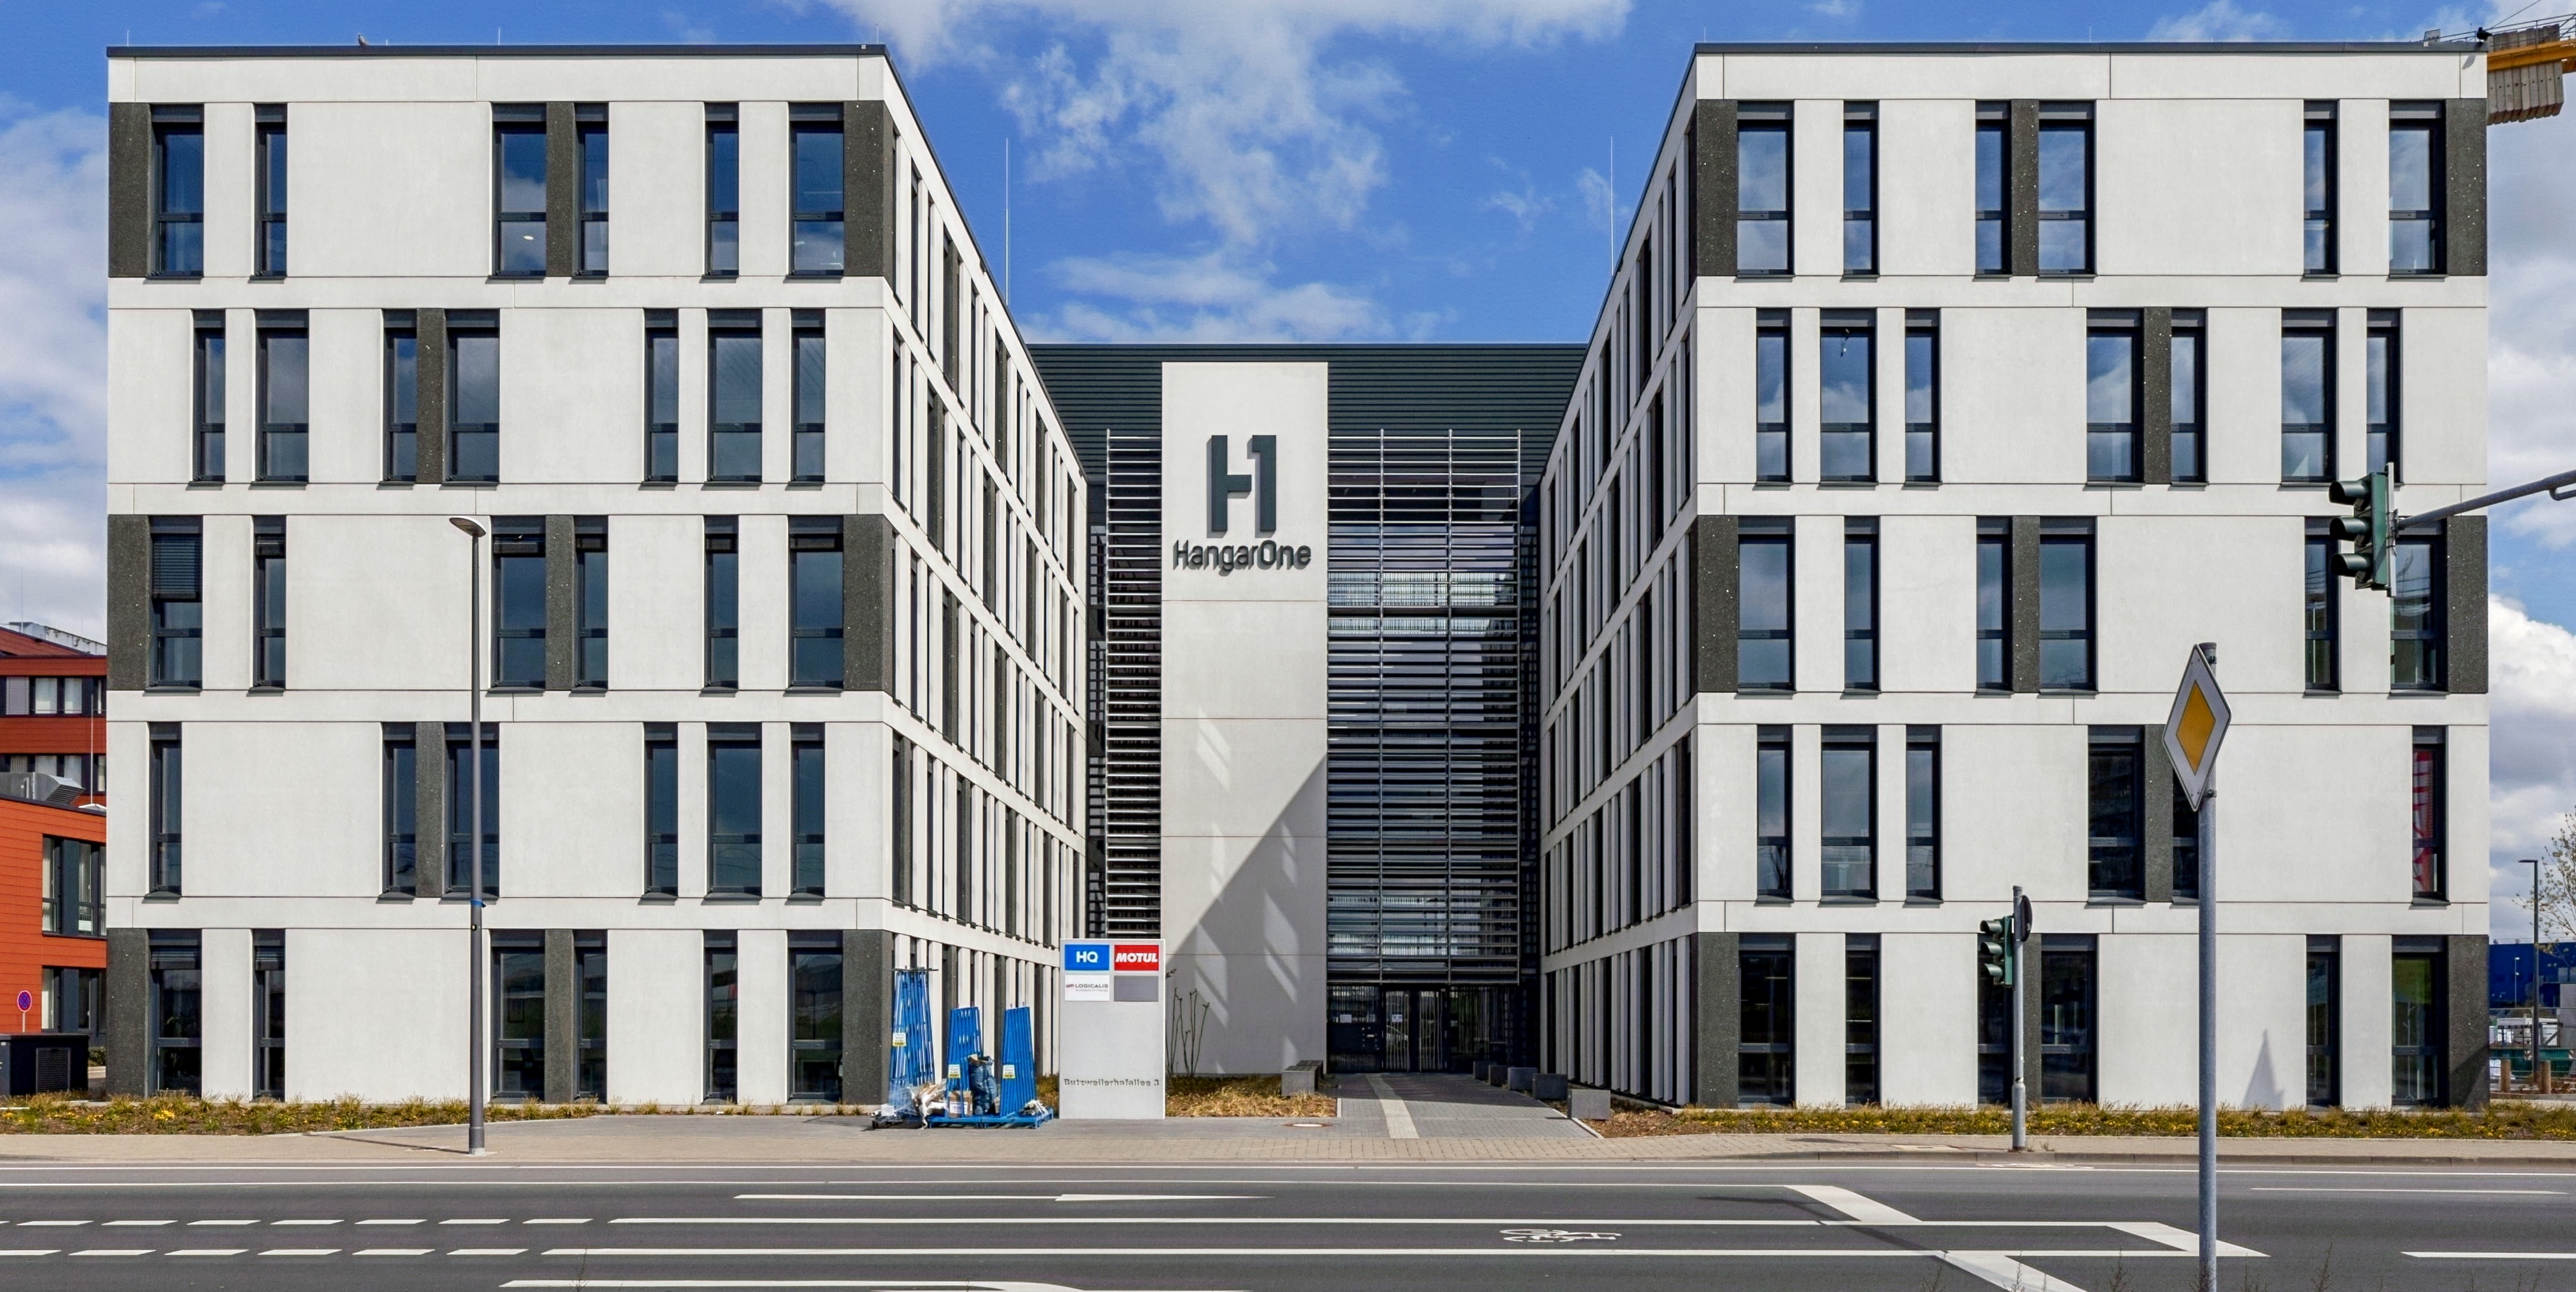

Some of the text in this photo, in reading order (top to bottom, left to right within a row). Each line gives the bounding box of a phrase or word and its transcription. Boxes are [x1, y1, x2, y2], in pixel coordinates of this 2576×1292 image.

[1211, 434, 1277, 532] H1
[1175, 539, 1312, 572] HangarOne
[1076, 951, 1099, 963] HQ
[1115, 953, 1158, 963] MOTUL
